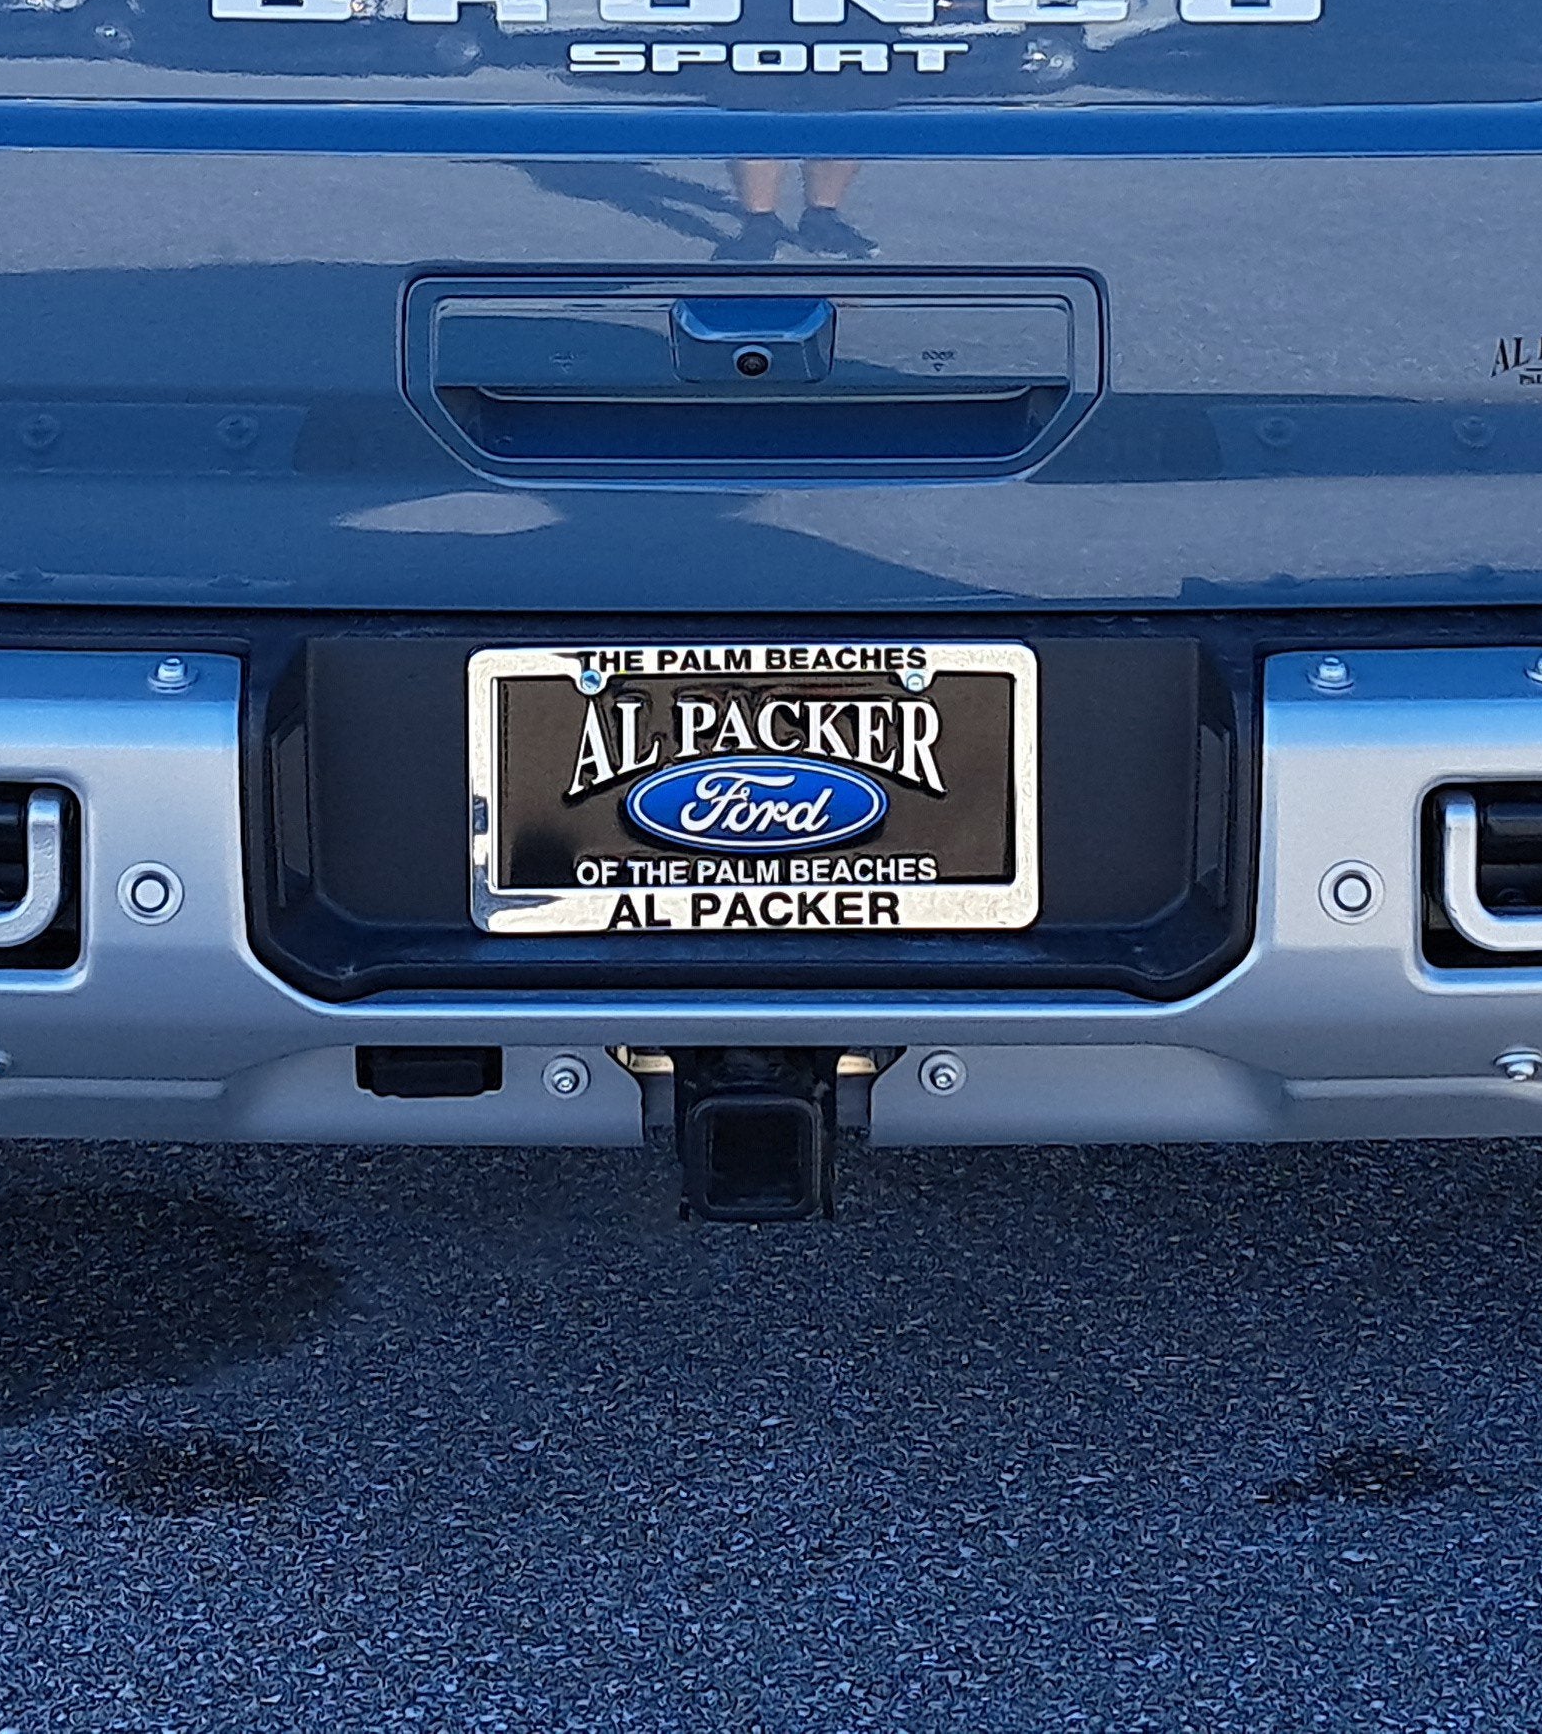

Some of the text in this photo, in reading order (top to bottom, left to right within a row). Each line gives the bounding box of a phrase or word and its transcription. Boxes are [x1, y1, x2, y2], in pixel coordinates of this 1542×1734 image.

[566, 41, 970, 75] SPORT
[1490, 336, 1532, 378] AL
[576, 647, 928, 673] THE PALM BEACHES
[567, 699, 947, 796] AL PACKER
[679, 771, 834, 835] Ford
[575, 857, 938, 886] OF THE PALM BEACHES
[607, 890, 901, 930] AL PACKER
